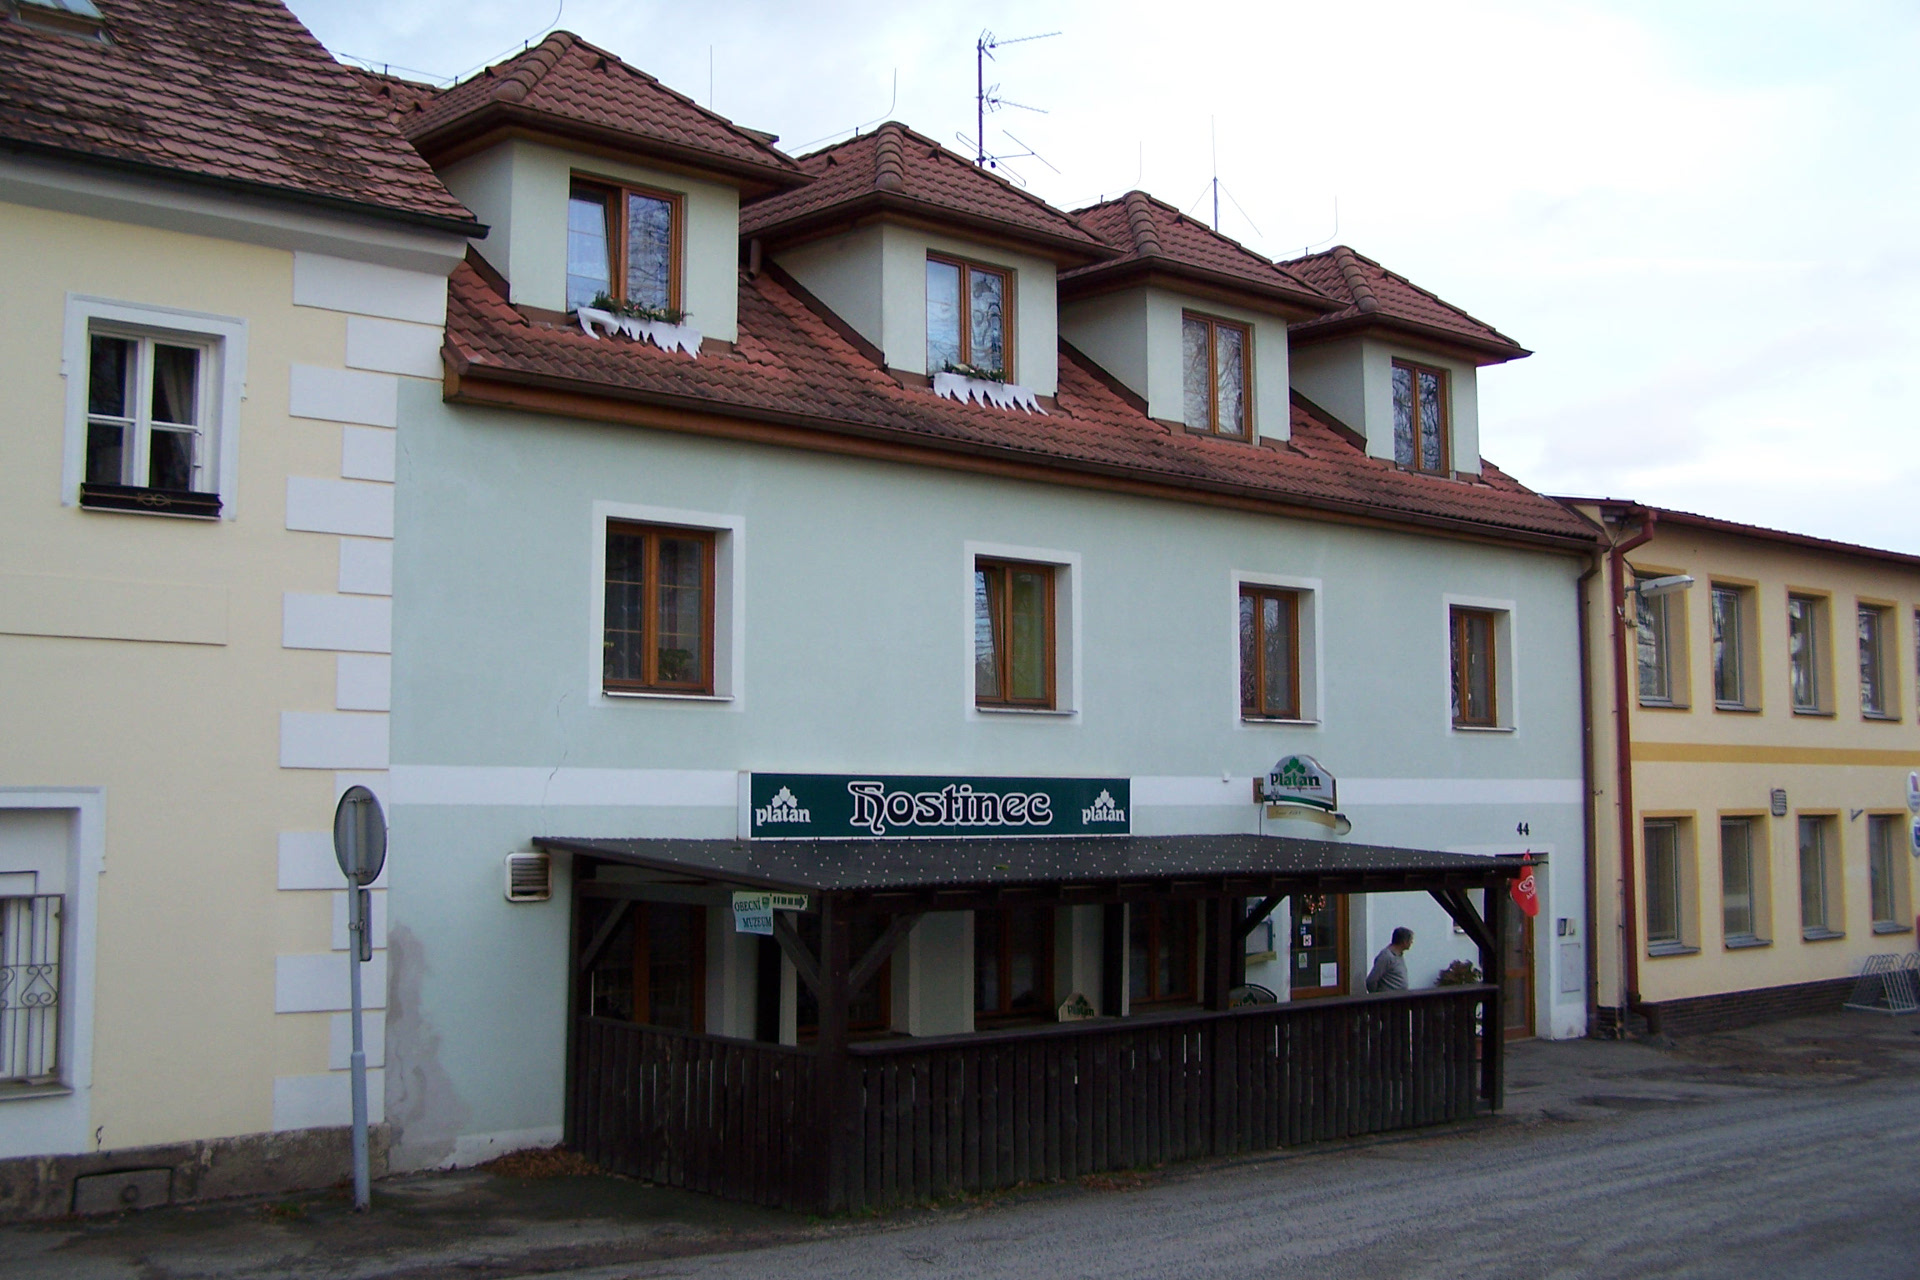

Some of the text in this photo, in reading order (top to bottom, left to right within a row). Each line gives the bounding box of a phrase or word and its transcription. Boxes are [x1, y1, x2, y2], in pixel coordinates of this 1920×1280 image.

[755, 804, 811, 826] platan
[1081, 805, 1126, 825] platan
[1516, 822, 1529, 836] 44
[742, 916, 772, 928] MUZEUM
